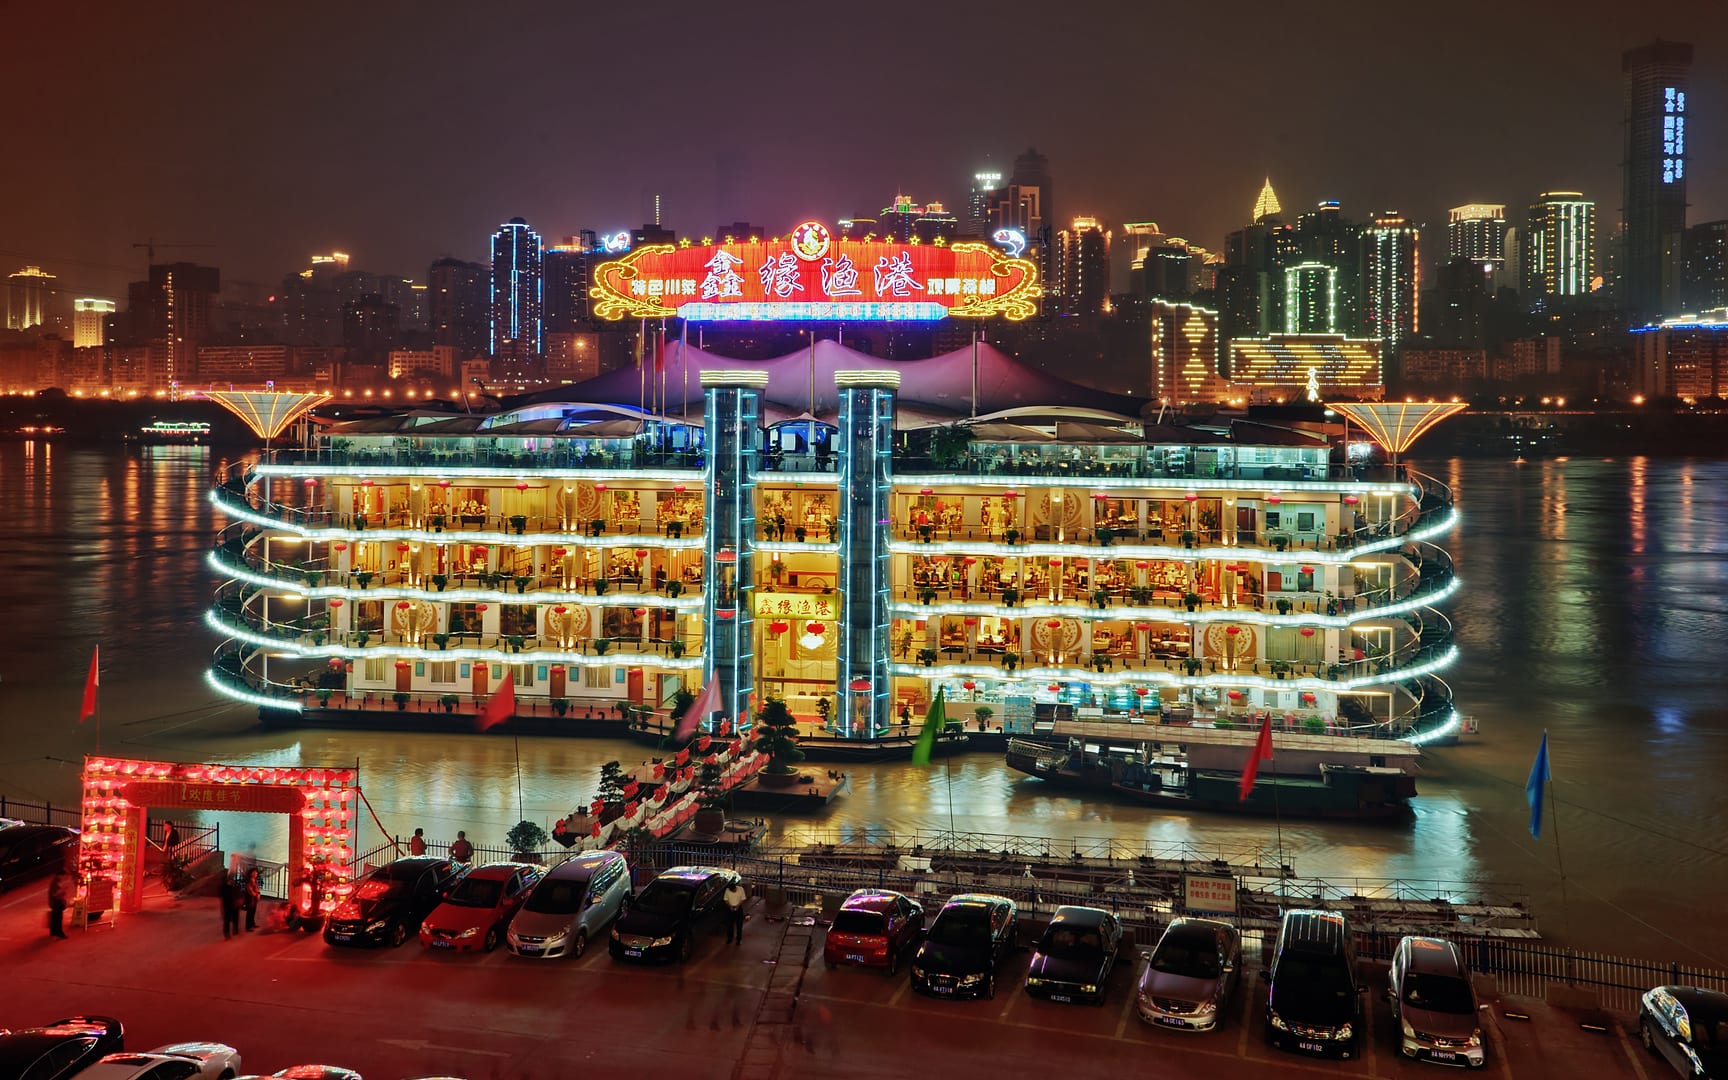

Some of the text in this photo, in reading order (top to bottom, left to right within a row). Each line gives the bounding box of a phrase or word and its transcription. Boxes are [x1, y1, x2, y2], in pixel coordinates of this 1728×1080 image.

[699, 249, 924, 299] 鑫缘渔港
[631, 279, 697, 296] 特色川菜
[759, 598, 832, 616] 鑫缘渔港
